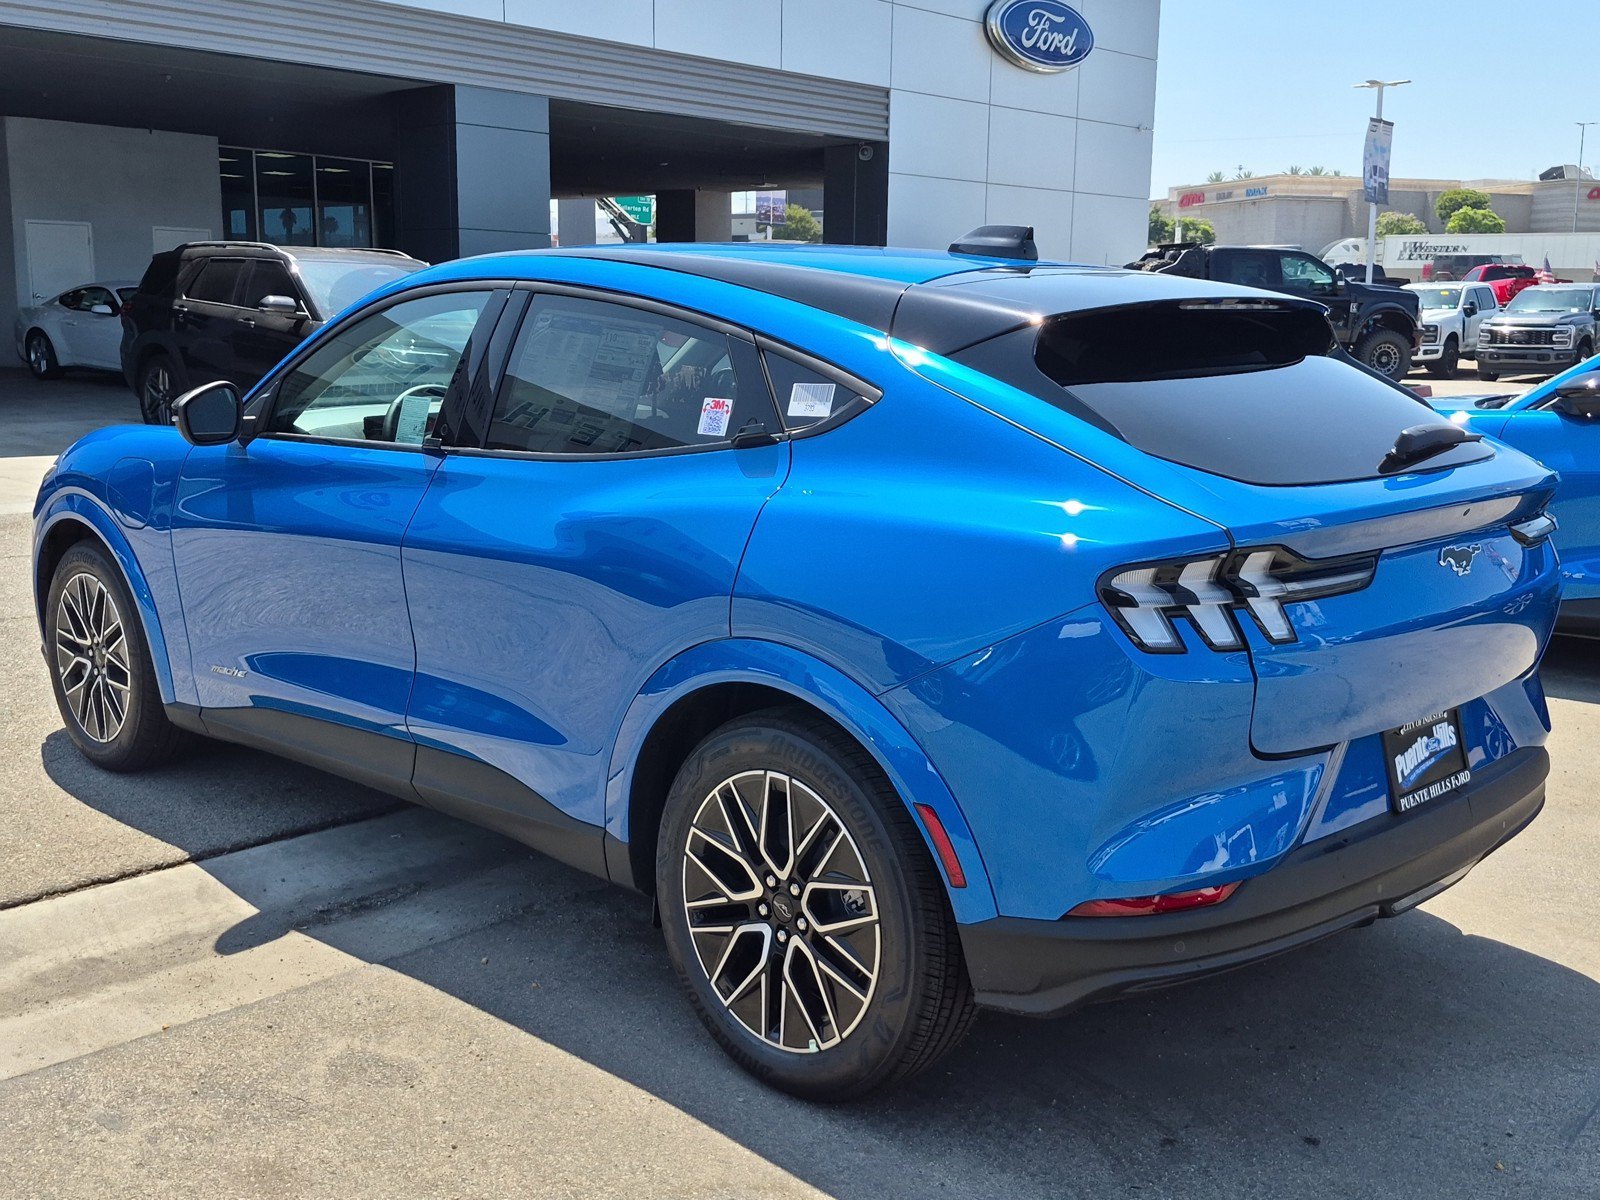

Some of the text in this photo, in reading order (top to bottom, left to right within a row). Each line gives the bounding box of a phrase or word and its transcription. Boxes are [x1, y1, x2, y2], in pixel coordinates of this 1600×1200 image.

[1021, 8, 1079, 56] Ford
[618, 203, 641, 213] ullerton
[1402, 240, 1470, 253] WESTERN
[711, 399, 726, 410] 3M
[1432, 721, 1457, 750] Hills
[767, 733, 884, 850] BRIDGESTONE
[1400, 787, 1430, 812] PUENTE
[1429, 778, 1452, 798] HILLS
[1450, 770, 1471, 789] FORD
